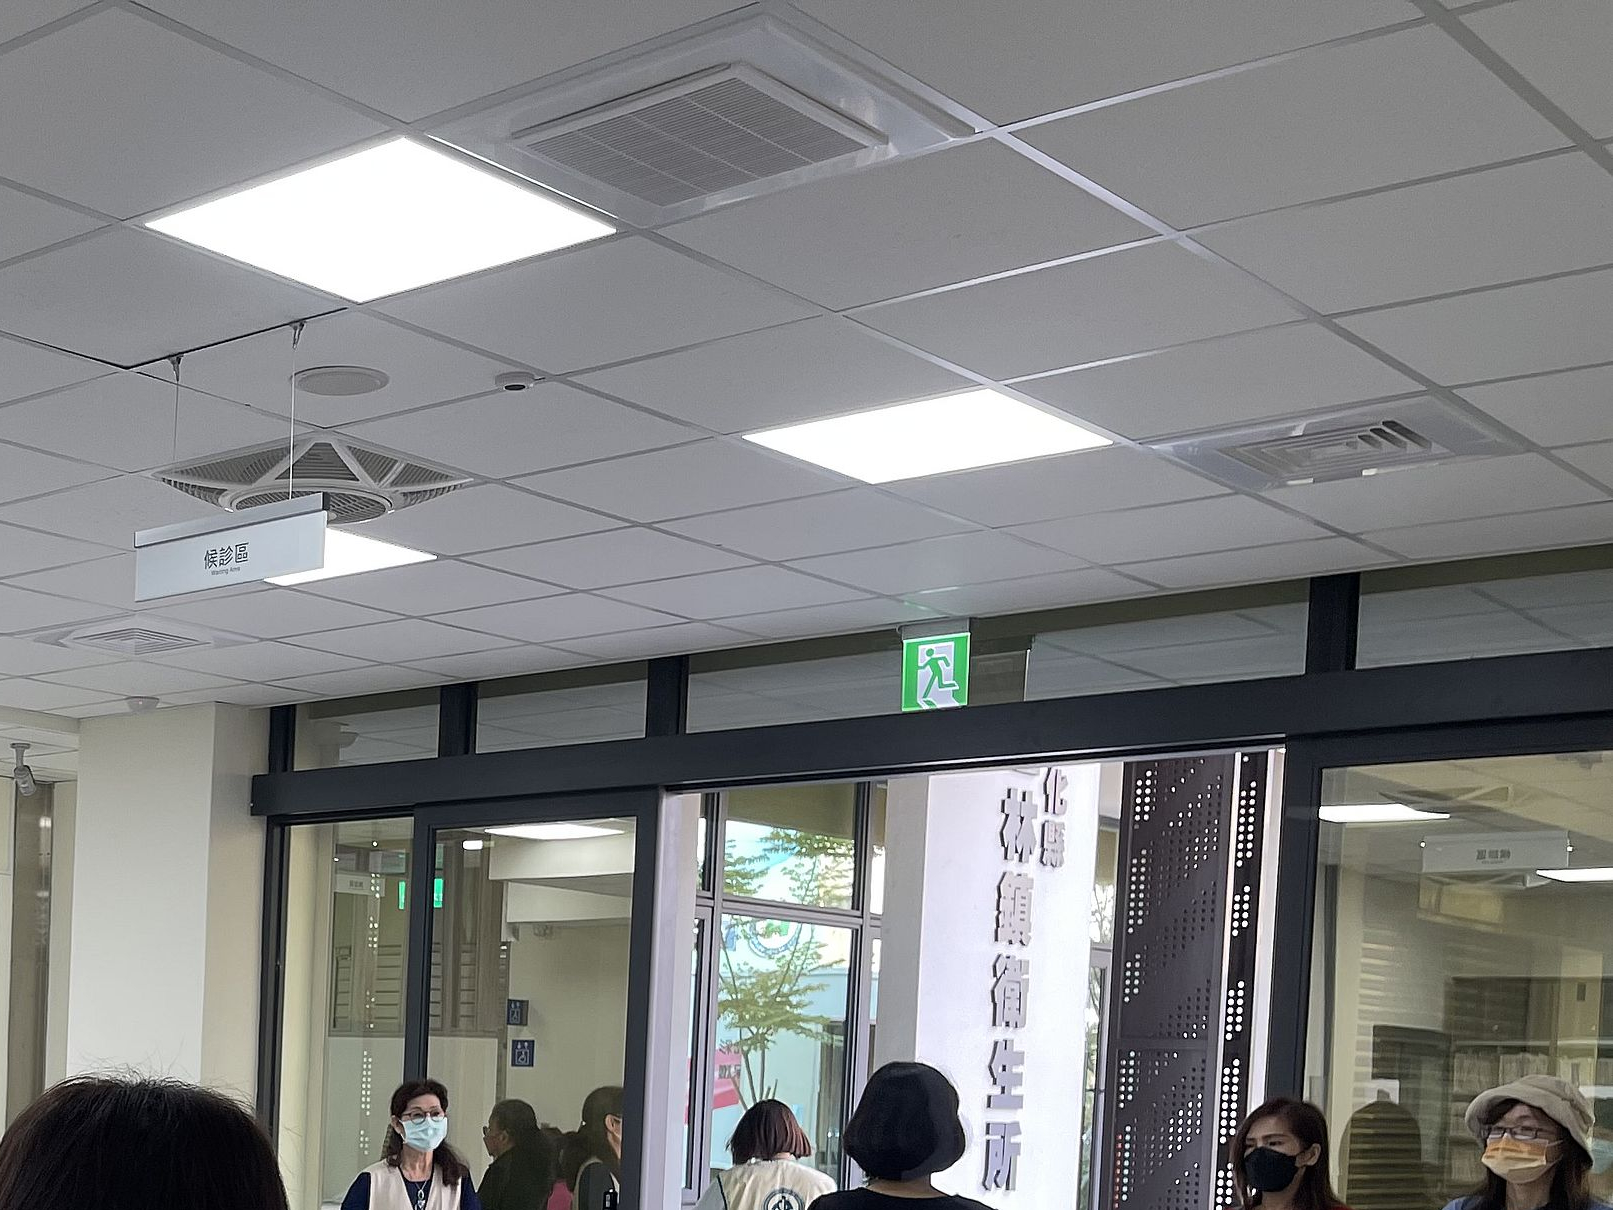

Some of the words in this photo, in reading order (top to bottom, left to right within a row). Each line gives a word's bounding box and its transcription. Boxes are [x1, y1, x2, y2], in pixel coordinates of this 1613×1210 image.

[204, 542, 249, 570] 候診區
[983, 767, 1039, 1193] 林鎮衛生所
